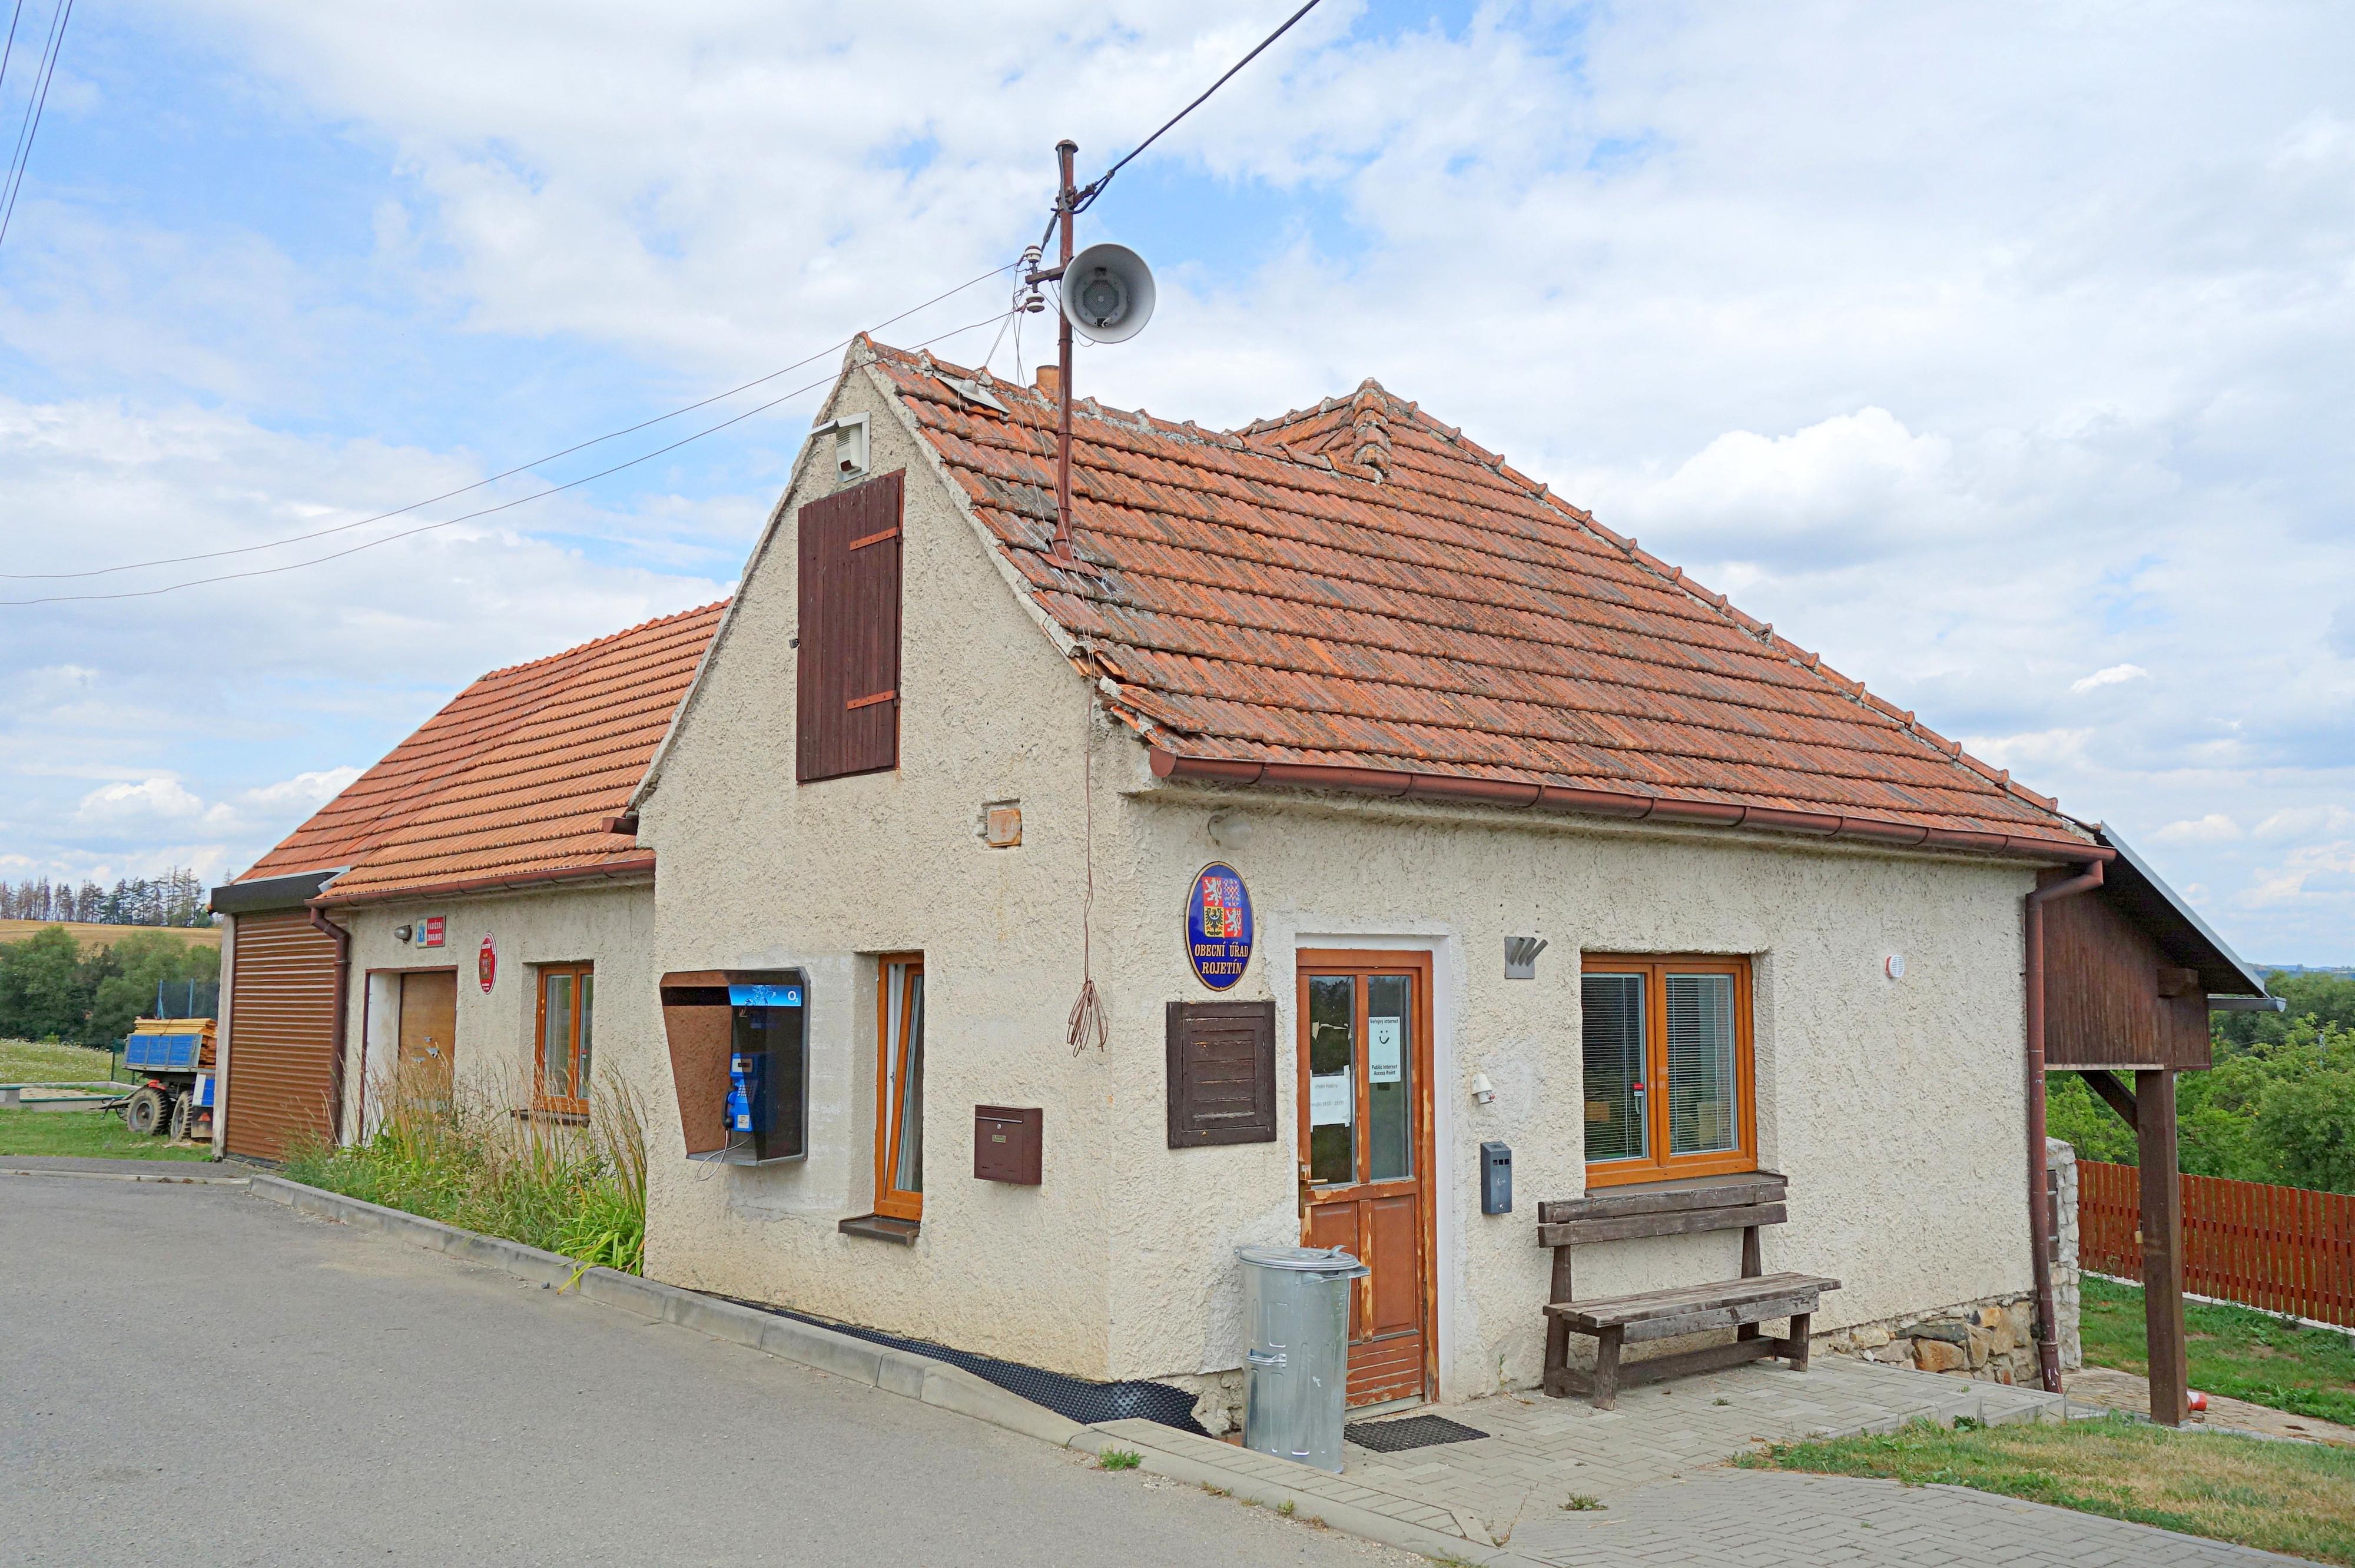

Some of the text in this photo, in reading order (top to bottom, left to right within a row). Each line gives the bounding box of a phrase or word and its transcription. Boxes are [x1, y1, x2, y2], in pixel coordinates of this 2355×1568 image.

[1195, 941, 1249, 957] OBECNÍ ÚŘAD
[1202, 959, 1242, 974] ROJETÍN
